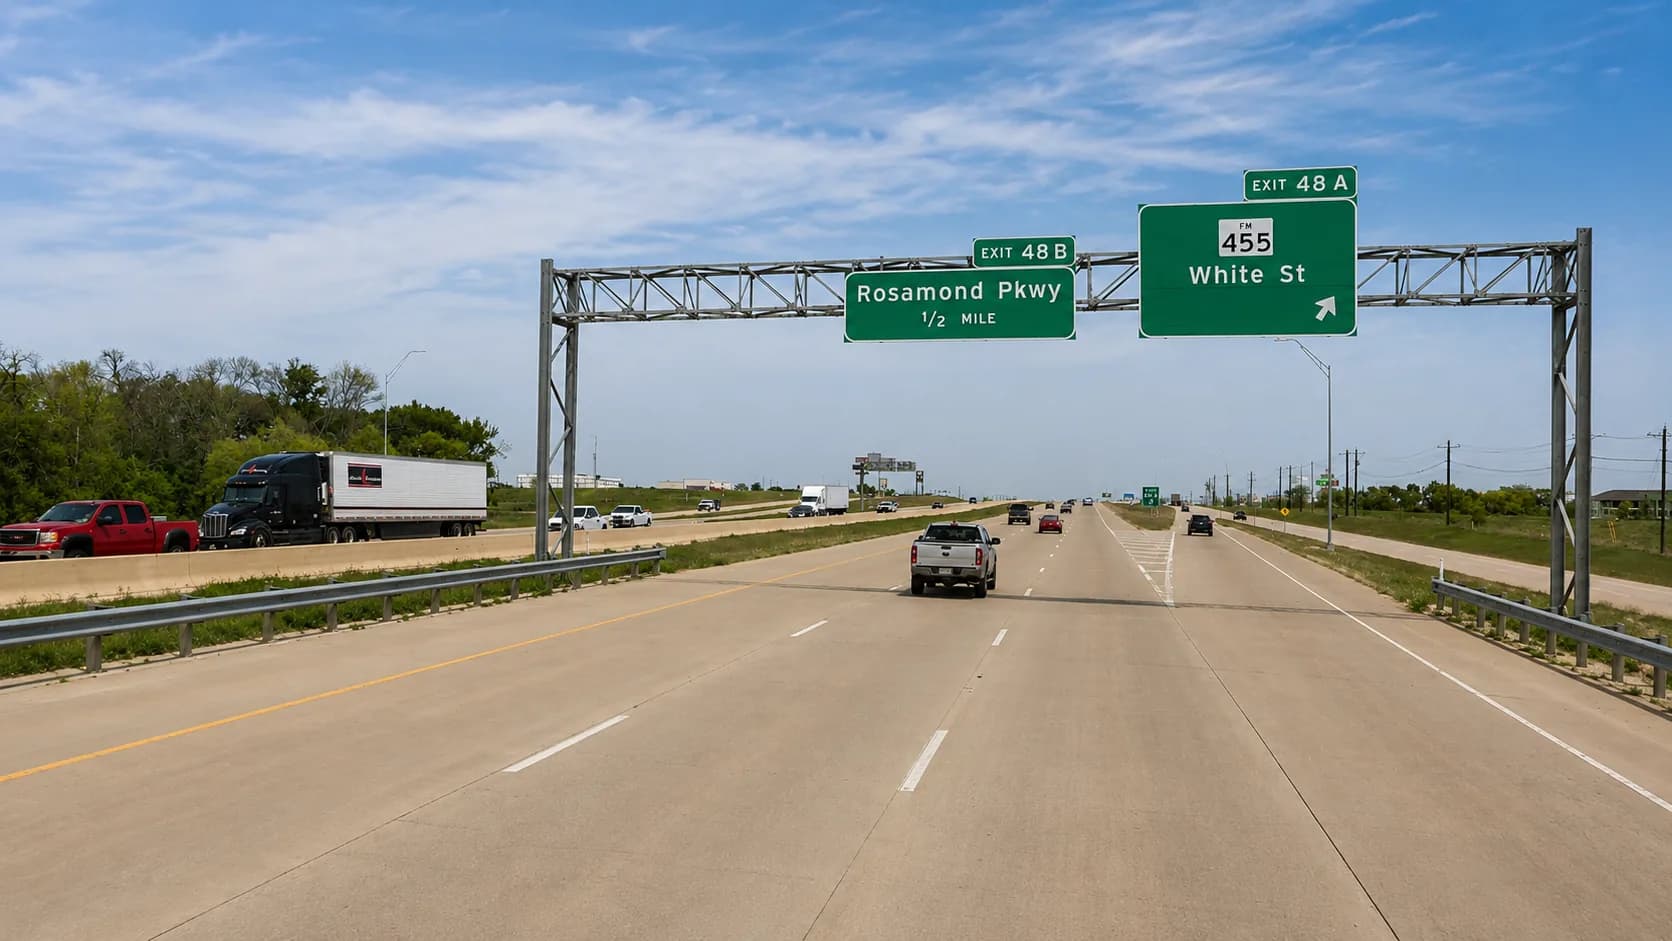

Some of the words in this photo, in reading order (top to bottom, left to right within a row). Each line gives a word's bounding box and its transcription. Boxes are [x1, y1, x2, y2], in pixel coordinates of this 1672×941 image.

[1252, 179, 1287, 192] EXIT
[1296, 175, 1326, 192] 48
[1333, 174, 1348, 191] A
[1239, 222, 1252, 230] FM
[981, 247, 1013, 259] EXIT
[1021, 243, 1049, 260] 48
[1054, 243, 1067, 259] B
[1221, 232, 1271, 253] 455
[1189, 264, 1264, 285] White
[1280, 264, 1305, 283] St
[857, 281, 984, 303] Rosamond
[999, 280, 1062, 303] Pkwy
[921, 311, 946, 328] 1/2
[961, 312, 997, 325] MILE
